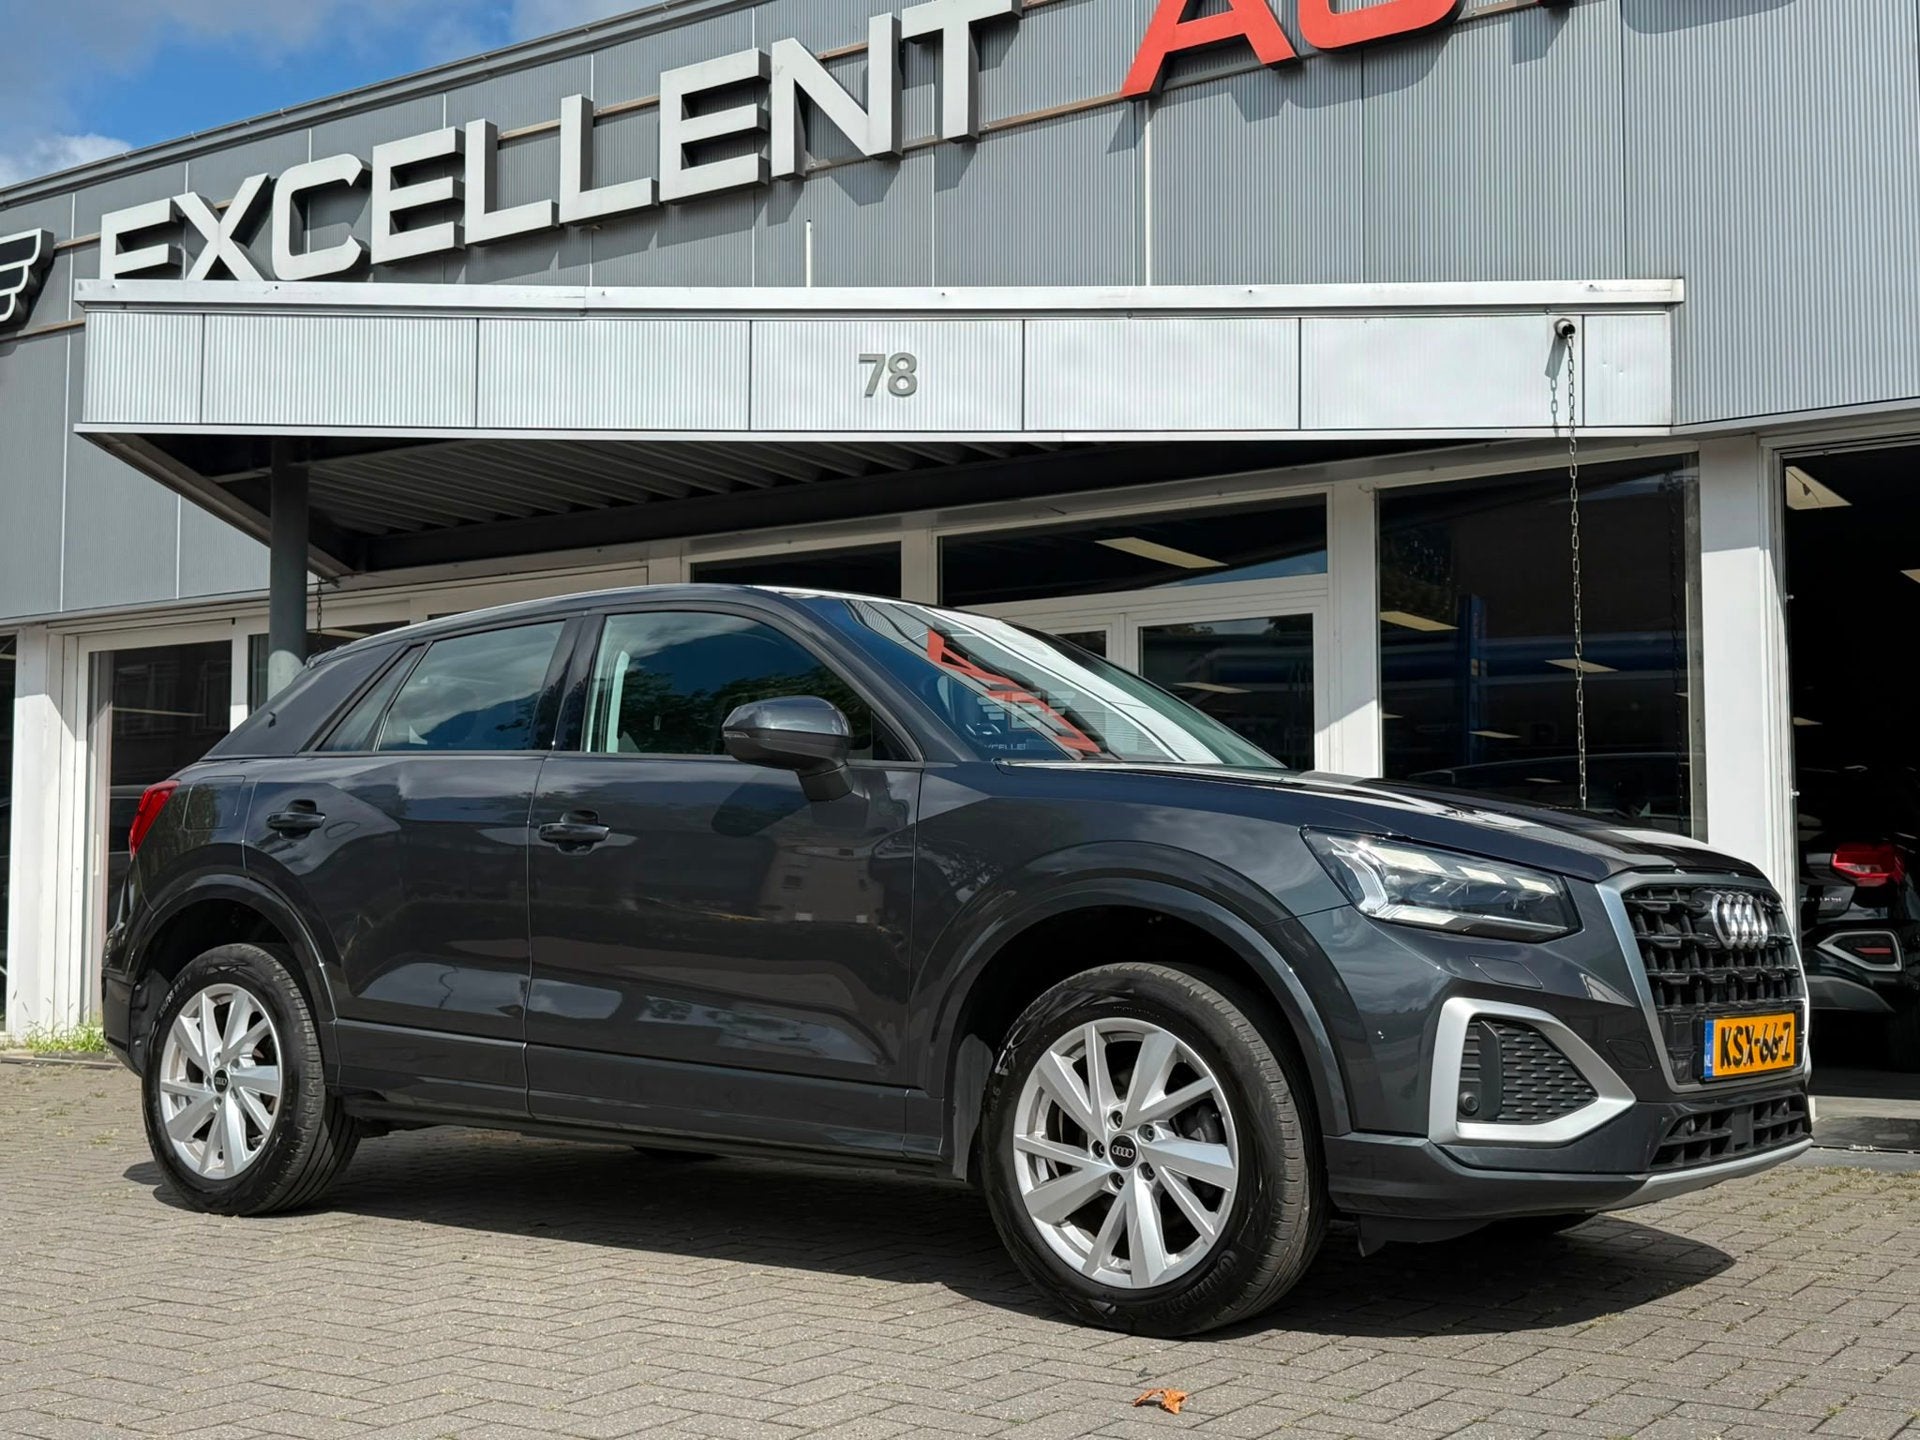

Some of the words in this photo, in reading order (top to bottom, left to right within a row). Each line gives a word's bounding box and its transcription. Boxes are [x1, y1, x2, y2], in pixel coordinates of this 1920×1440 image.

[101, 0, 1020, 282] EXCELLENT
[858, 352, 918, 398] 78
[1720, 1021, 1792, 1069] KSX-66-Z
